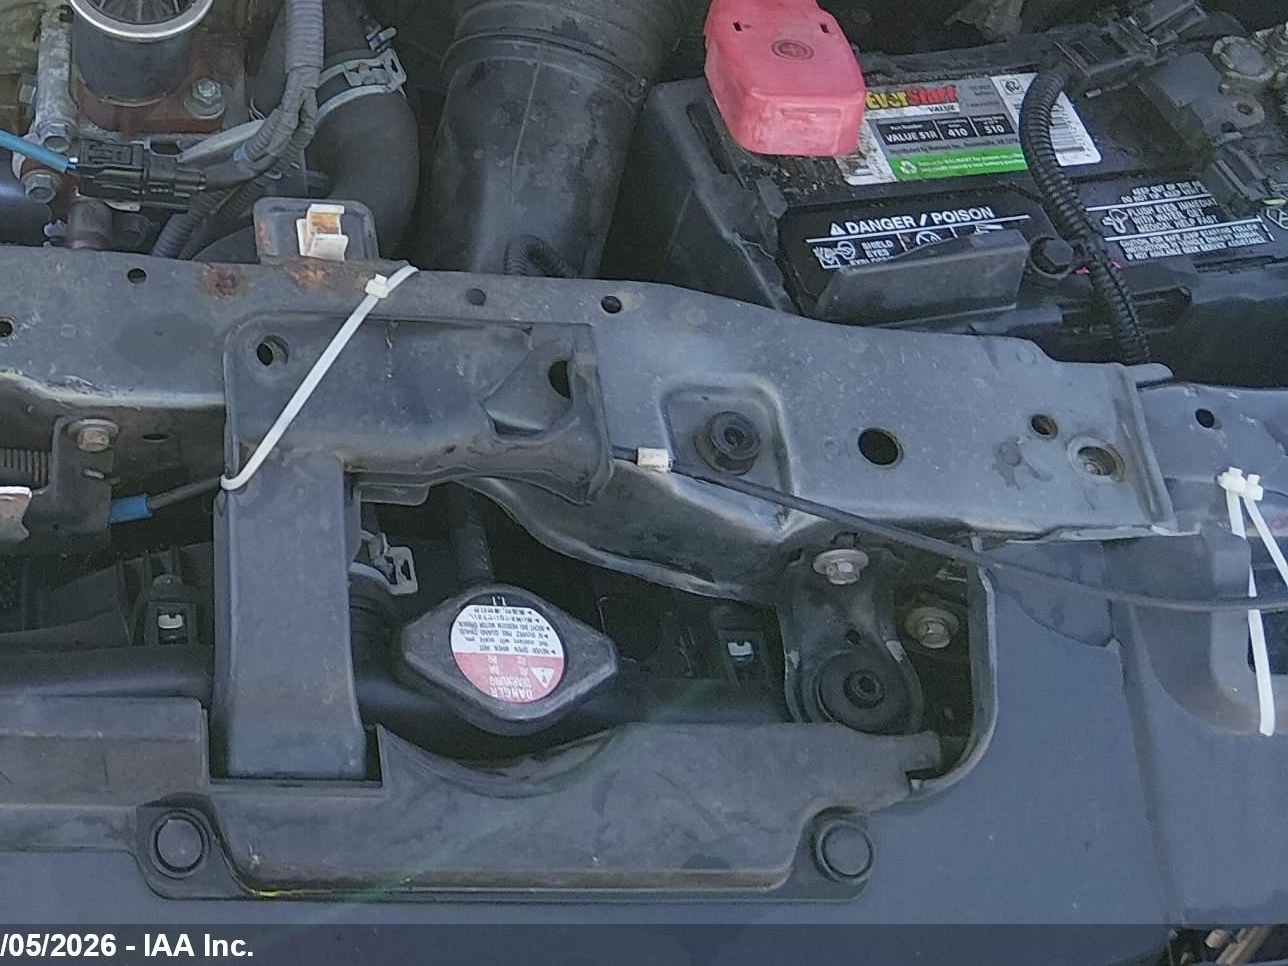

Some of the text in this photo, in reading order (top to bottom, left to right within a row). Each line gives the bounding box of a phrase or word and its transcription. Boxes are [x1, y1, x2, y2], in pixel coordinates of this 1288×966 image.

[927, 104, 956, 114] VALUE
[947, 128, 968, 138] 410
[983, 124, 1005, 134] 510
[885, 131, 918, 143] VALUE
[1126, 206, 1156, 218] FLUSH
[1154, 202, 1179, 214] EYES
[1187, 207, 1206, 218] GET
[845, 215, 916, 235] DANGER
[929, 206, 996, 225] POISON
[1136, 214, 1220, 234] MEDICAL HELP FAST
[861, 240, 894, 250] SHIELD
[864, 248, 890, 259] EYES
[489, 687, 533, 701] DANGER
